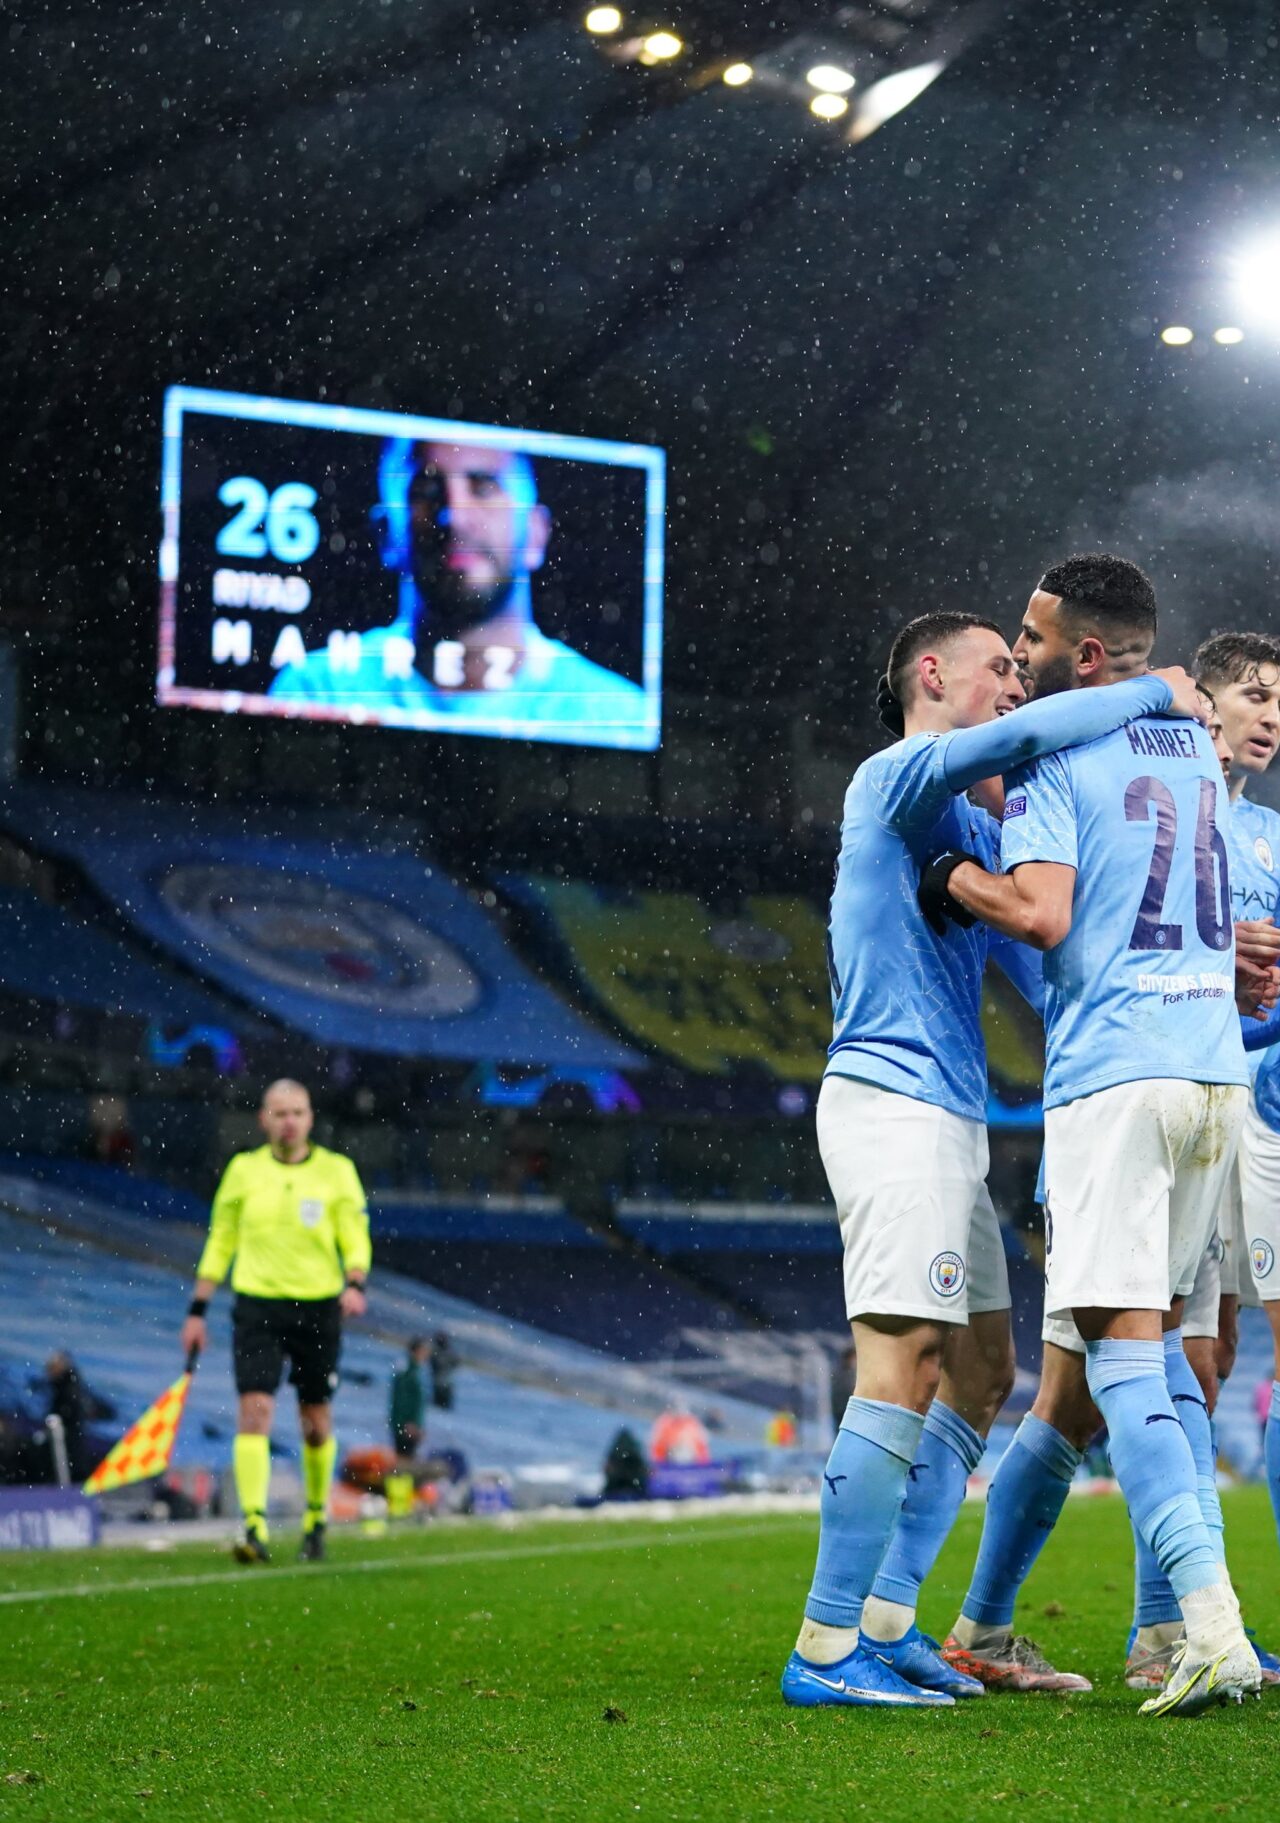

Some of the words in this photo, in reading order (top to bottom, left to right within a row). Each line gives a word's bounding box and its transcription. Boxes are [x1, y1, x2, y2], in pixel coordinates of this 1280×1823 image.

[216, 475, 320, 564] 26
[212, 617, 517, 691] MAHREZ
[1124, 724, 1201, 758] MAHREZ
[1123, 774, 1232, 951] 26
[1162, 991, 1184, 1006] FOR
